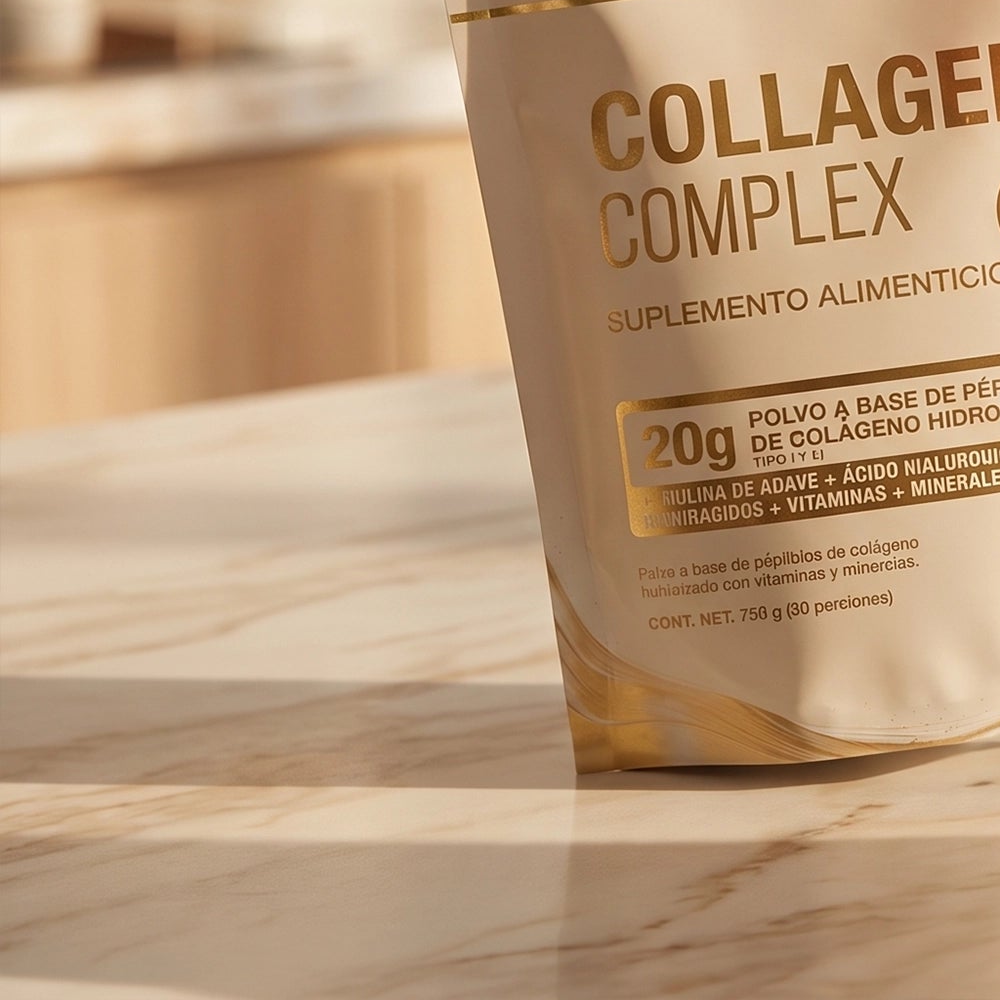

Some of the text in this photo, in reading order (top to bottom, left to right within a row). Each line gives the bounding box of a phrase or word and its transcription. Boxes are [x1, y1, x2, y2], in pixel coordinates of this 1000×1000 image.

[600, 157, 913, 269] COMPLEX
[608, 288, 809, 333] SUPLEMENTO
[748, 402, 827, 428] POLVO
[856, 391, 918, 415] BASE
[925, 385, 956, 406] DE
[640, 423, 736, 471] 20g
[751, 432, 783, 453] DE
[753, 453, 787, 468] TIPO
[798, 451, 807, 462] Y
[732, 481, 755, 499] DE
[760, 472, 819, 495] ADAVE
[843, 461, 899, 484] ÁCIDO
[786, 485, 887, 513] VITAMINAS
[680, 566, 688, 577] a
[692, 562, 727, 576] base
[731, 558, 750, 572] de
[827, 546, 846, 560] de
[850, 538, 919, 557] colágeno
[723, 578, 750, 591] con
[754, 568, 826, 587] vitaminas
[829, 568, 838, 582] y
[648, 614, 695, 630] CONT.
[700, 610, 735, 627] NET.
[772, 607, 782, 622] g
[786, 601, 810, 620] (30
